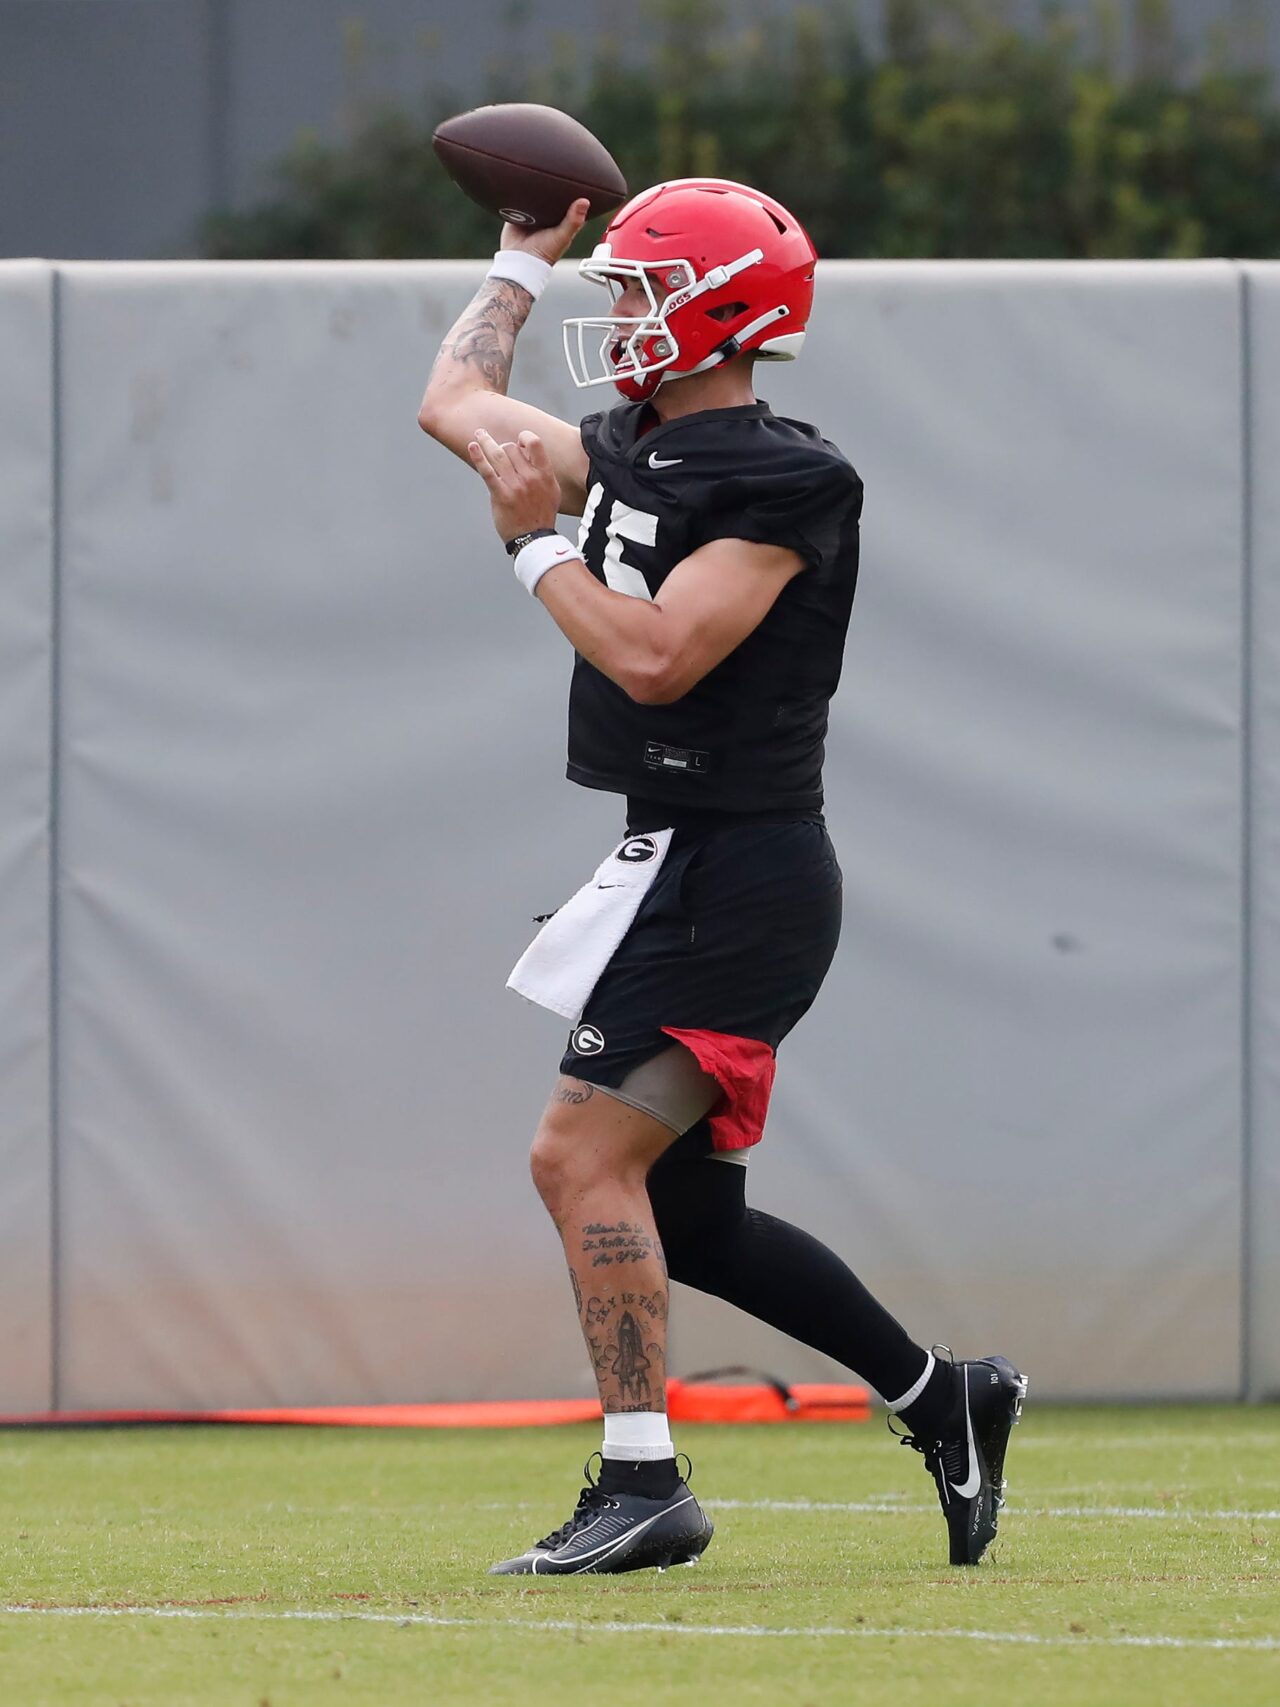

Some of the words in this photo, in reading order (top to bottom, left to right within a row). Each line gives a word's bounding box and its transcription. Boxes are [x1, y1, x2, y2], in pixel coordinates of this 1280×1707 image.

[665, 292, 691, 315] OGS
[617, 838, 656, 863] G
[572, 1024, 605, 1055] G
